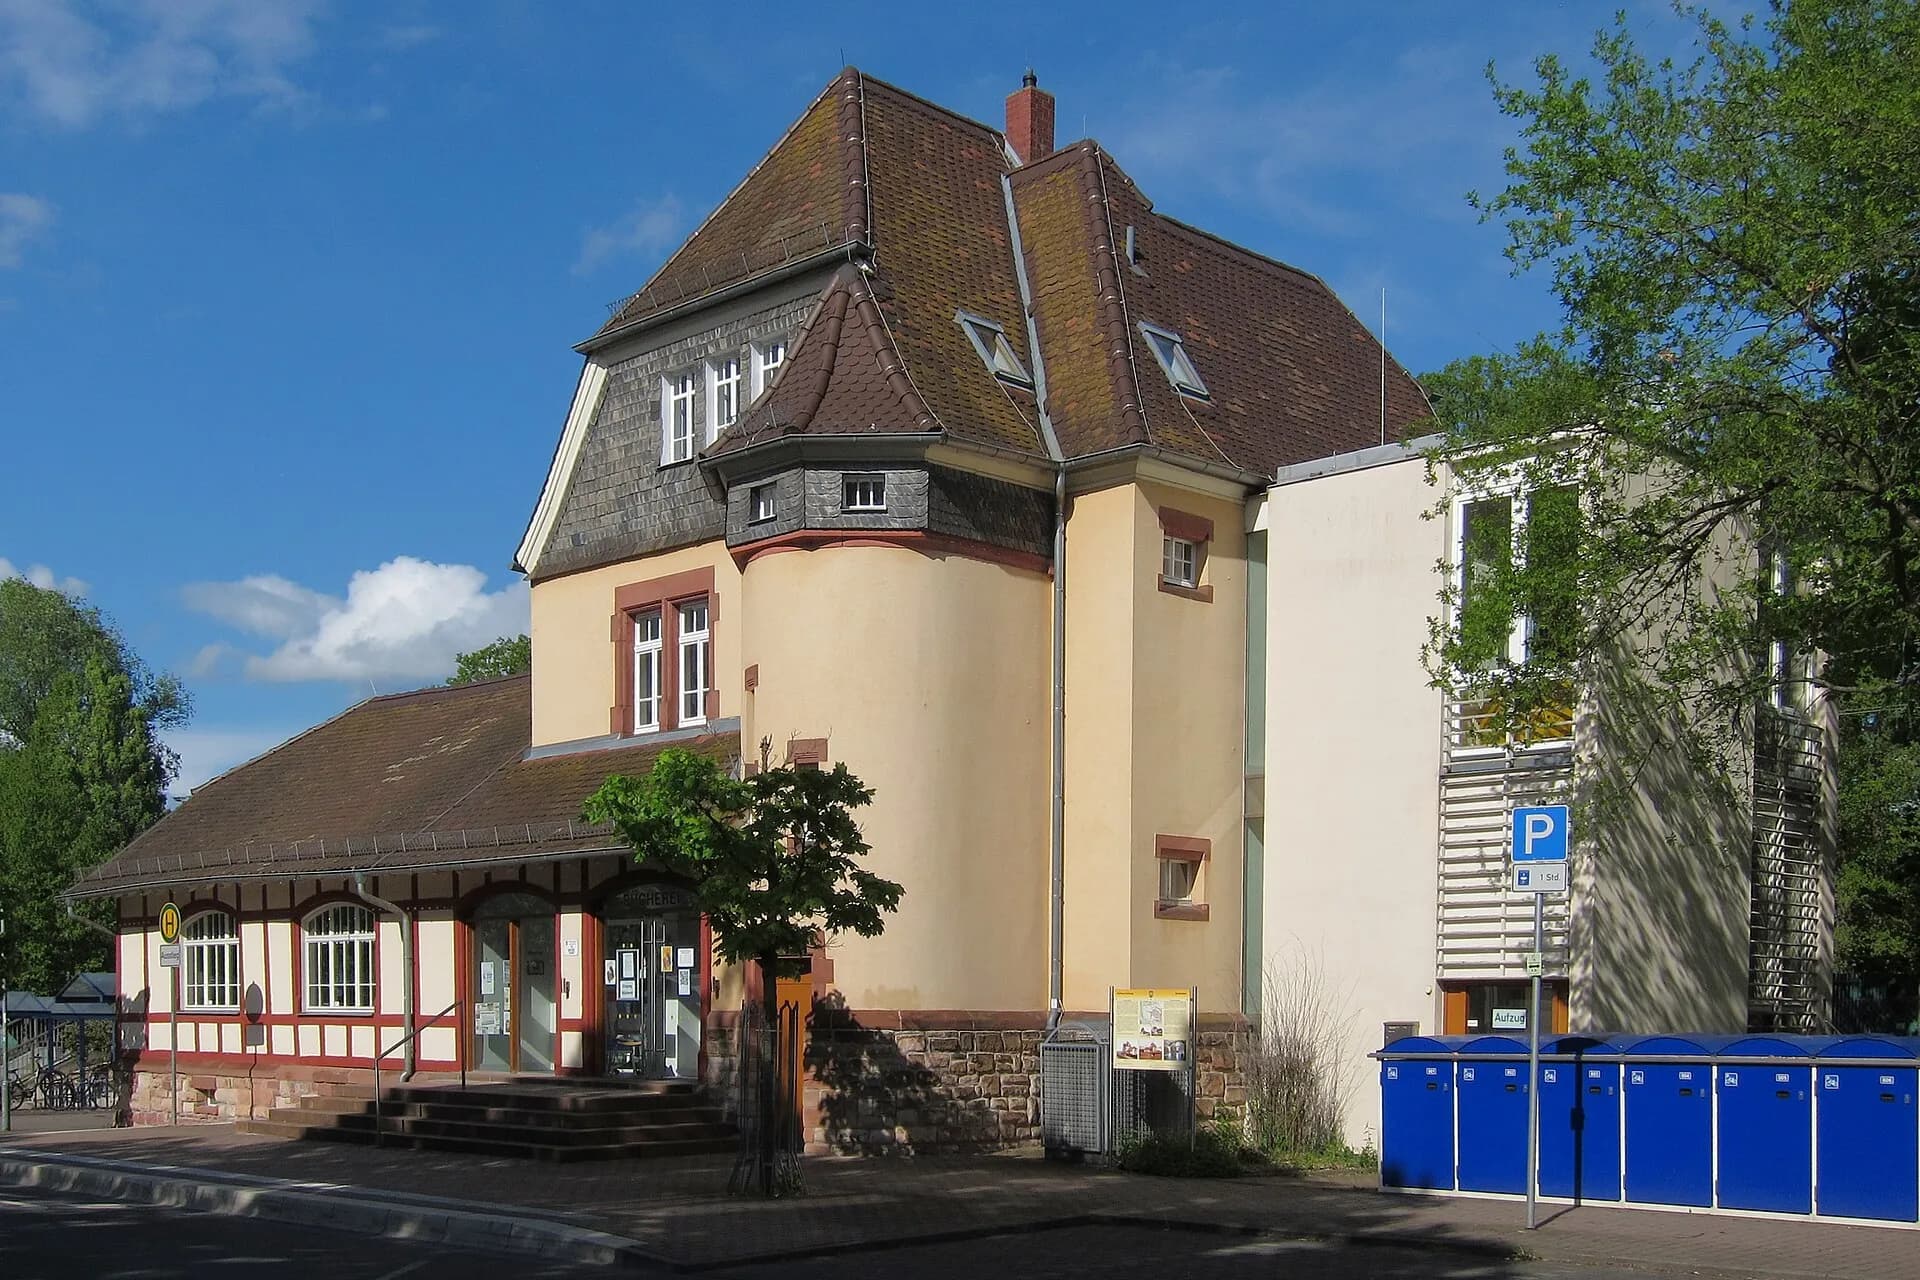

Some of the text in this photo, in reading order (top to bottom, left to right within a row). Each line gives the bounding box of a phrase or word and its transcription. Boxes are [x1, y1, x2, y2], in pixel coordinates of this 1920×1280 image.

[1525, 814, 1555, 855] P
[1540, 873, 1544, 881] 1
[165, 912, 175, 935] H
[1495, 1012, 1525, 1025] Aufzug
